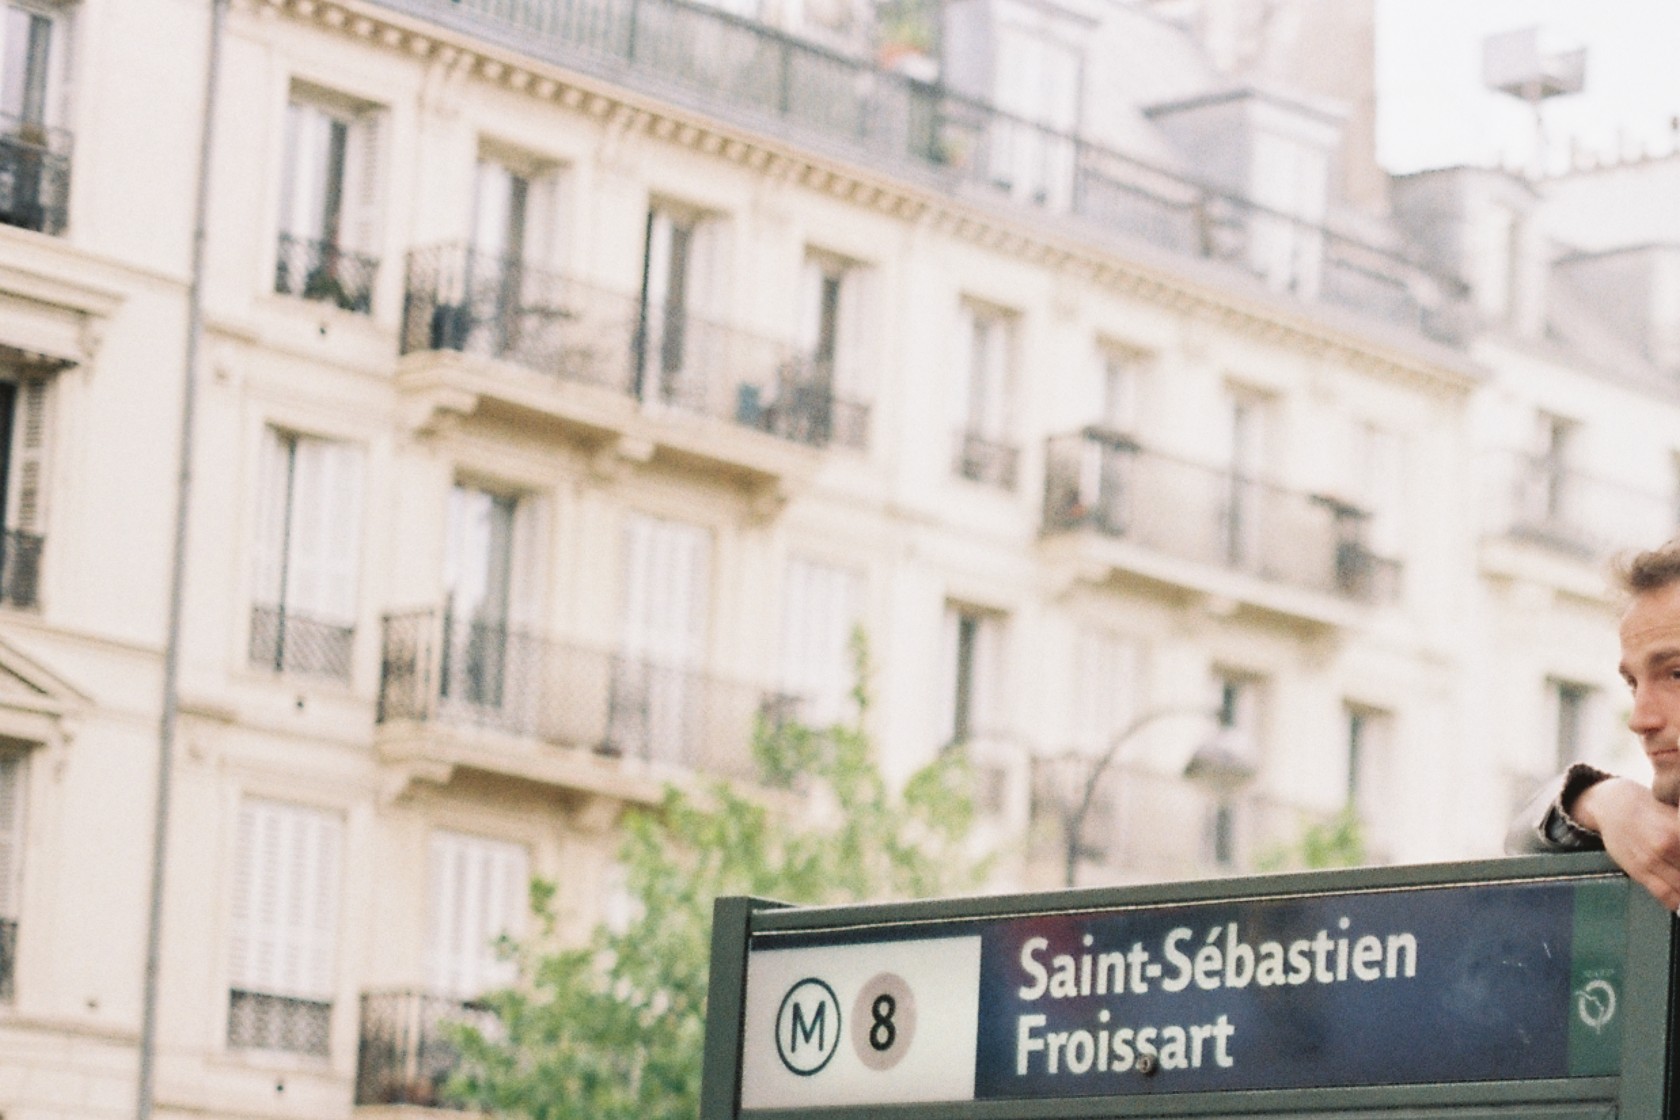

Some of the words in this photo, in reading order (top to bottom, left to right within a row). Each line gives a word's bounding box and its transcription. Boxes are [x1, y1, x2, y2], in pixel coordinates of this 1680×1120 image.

[1018, 916, 1418, 1001] Saint-Sébastien
[869, 994, 896, 1051] 8
[1015, 1008, 1235, 1076] Froissart
